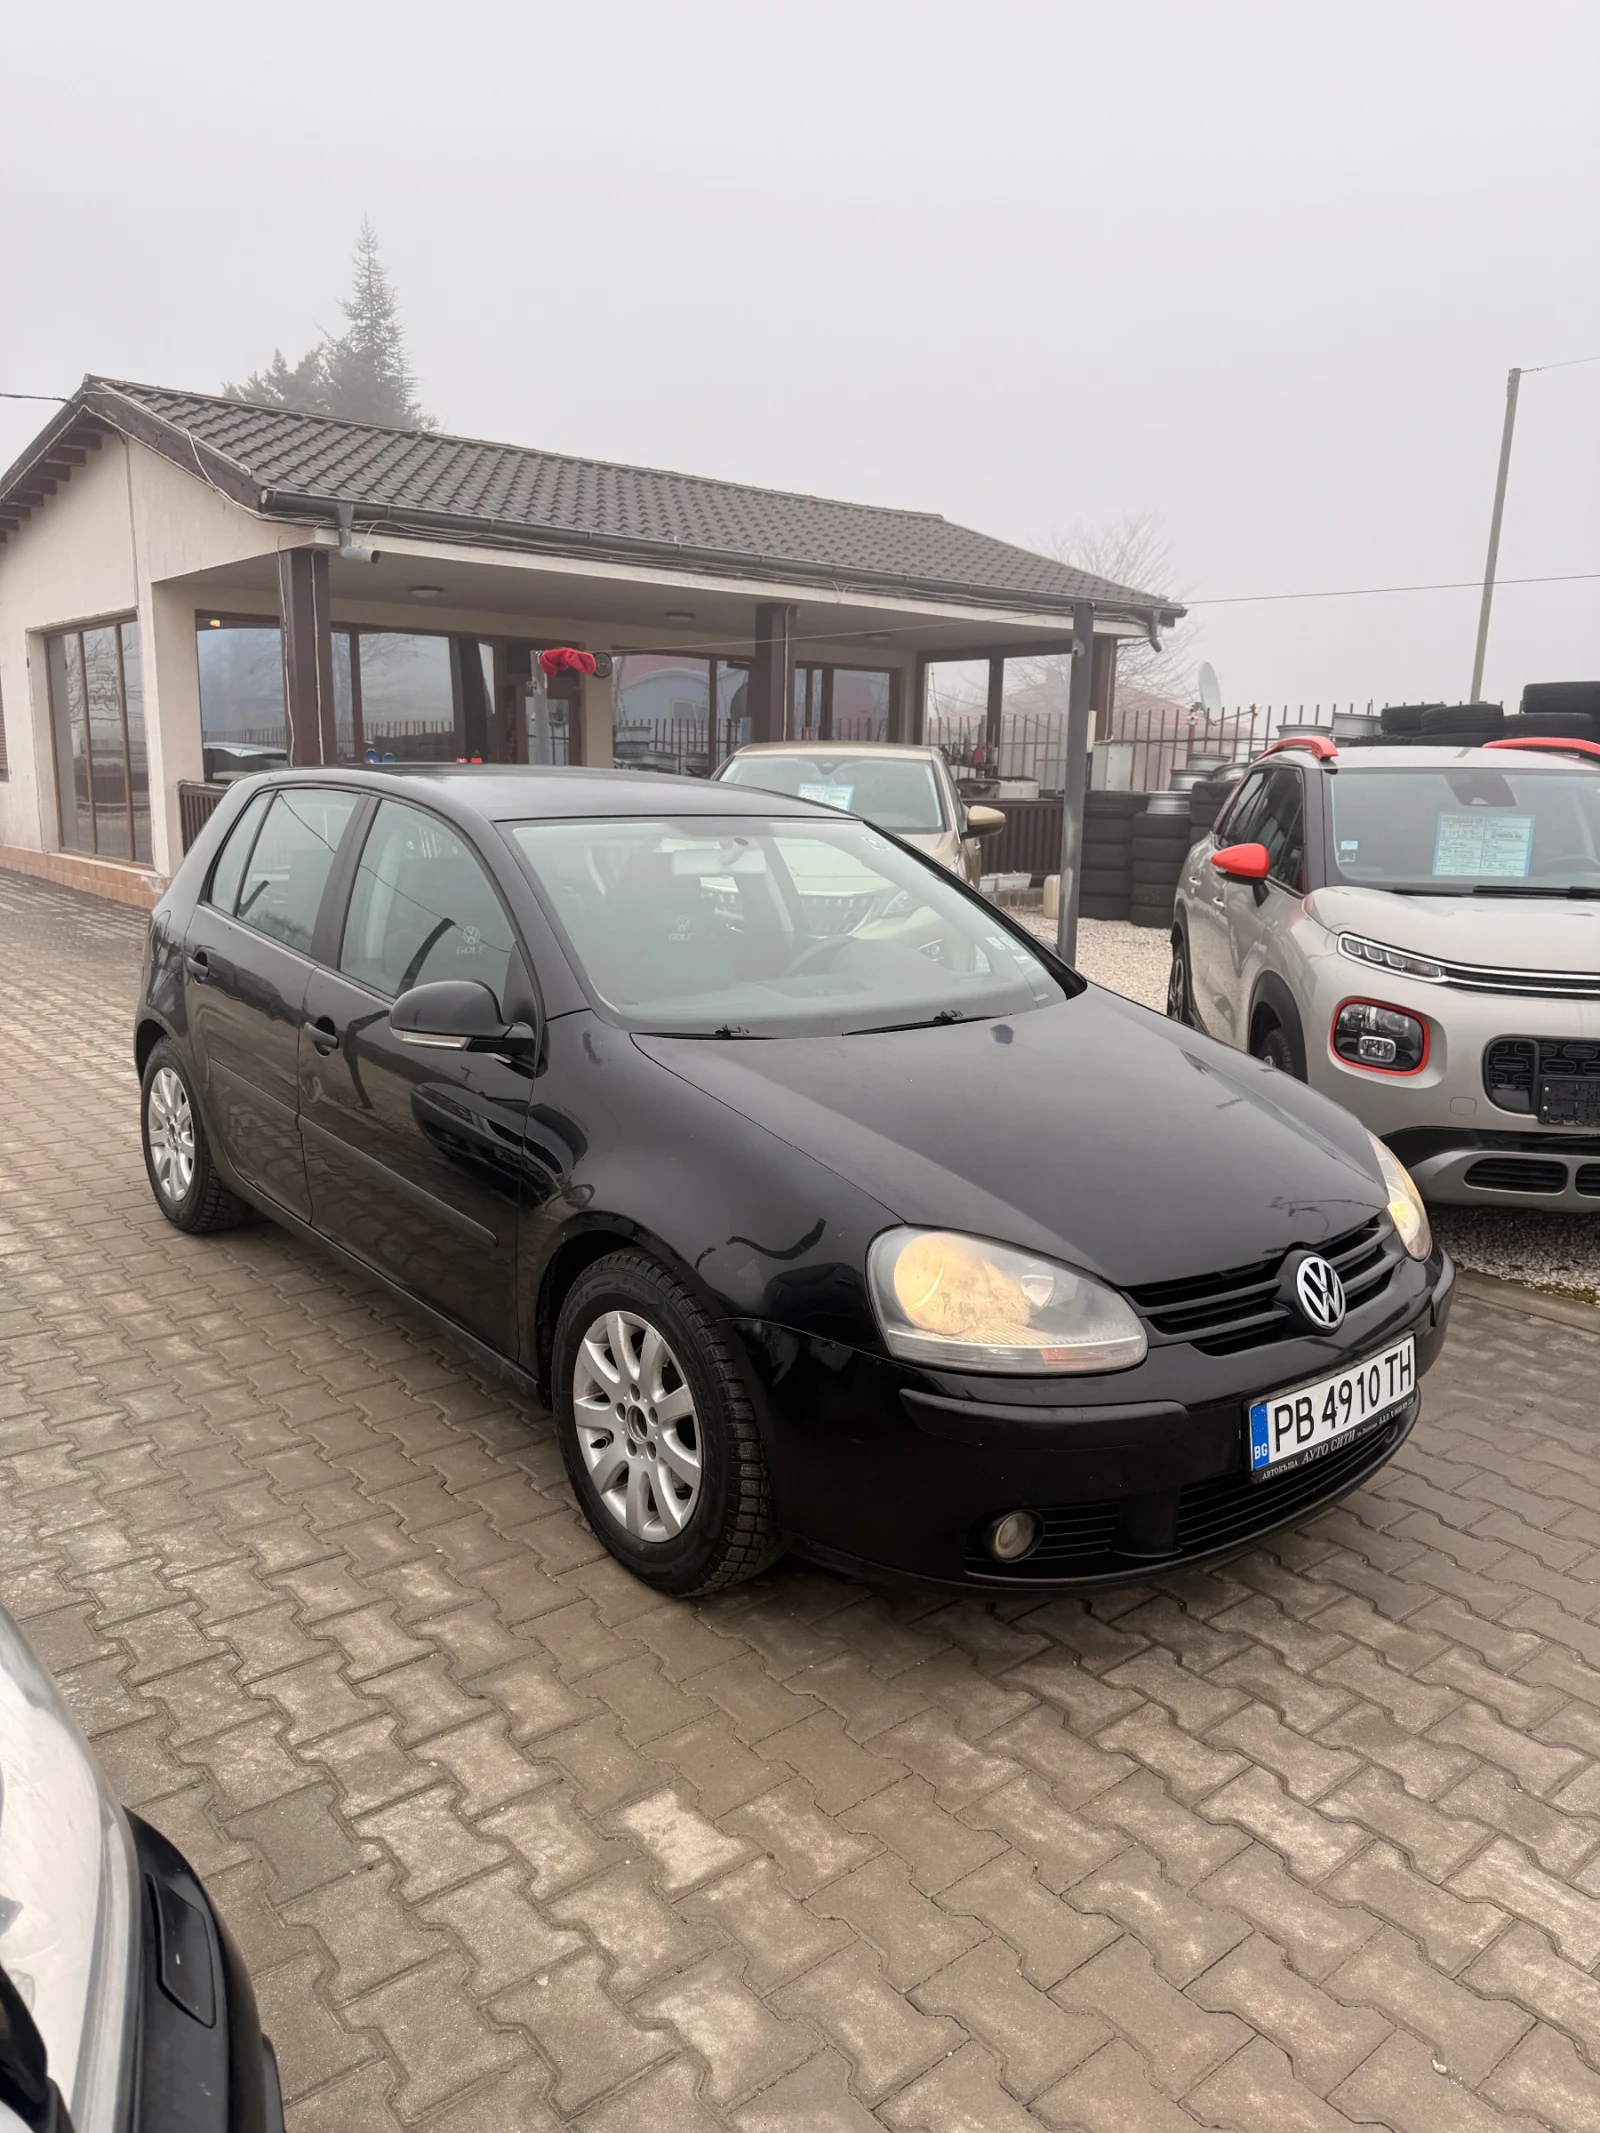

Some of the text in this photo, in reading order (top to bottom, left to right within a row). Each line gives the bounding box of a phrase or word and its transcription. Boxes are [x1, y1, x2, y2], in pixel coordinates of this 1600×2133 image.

[456, 945, 486, 955] GOLF
[1274, 1345, 1412, 1453] PB 4910 TH
[1254, 1442, 1268, 1460] BG
[1302, 1443, 1330, 1465] АУТО
[1330, 1429, 1356, 1452] СИТИ
